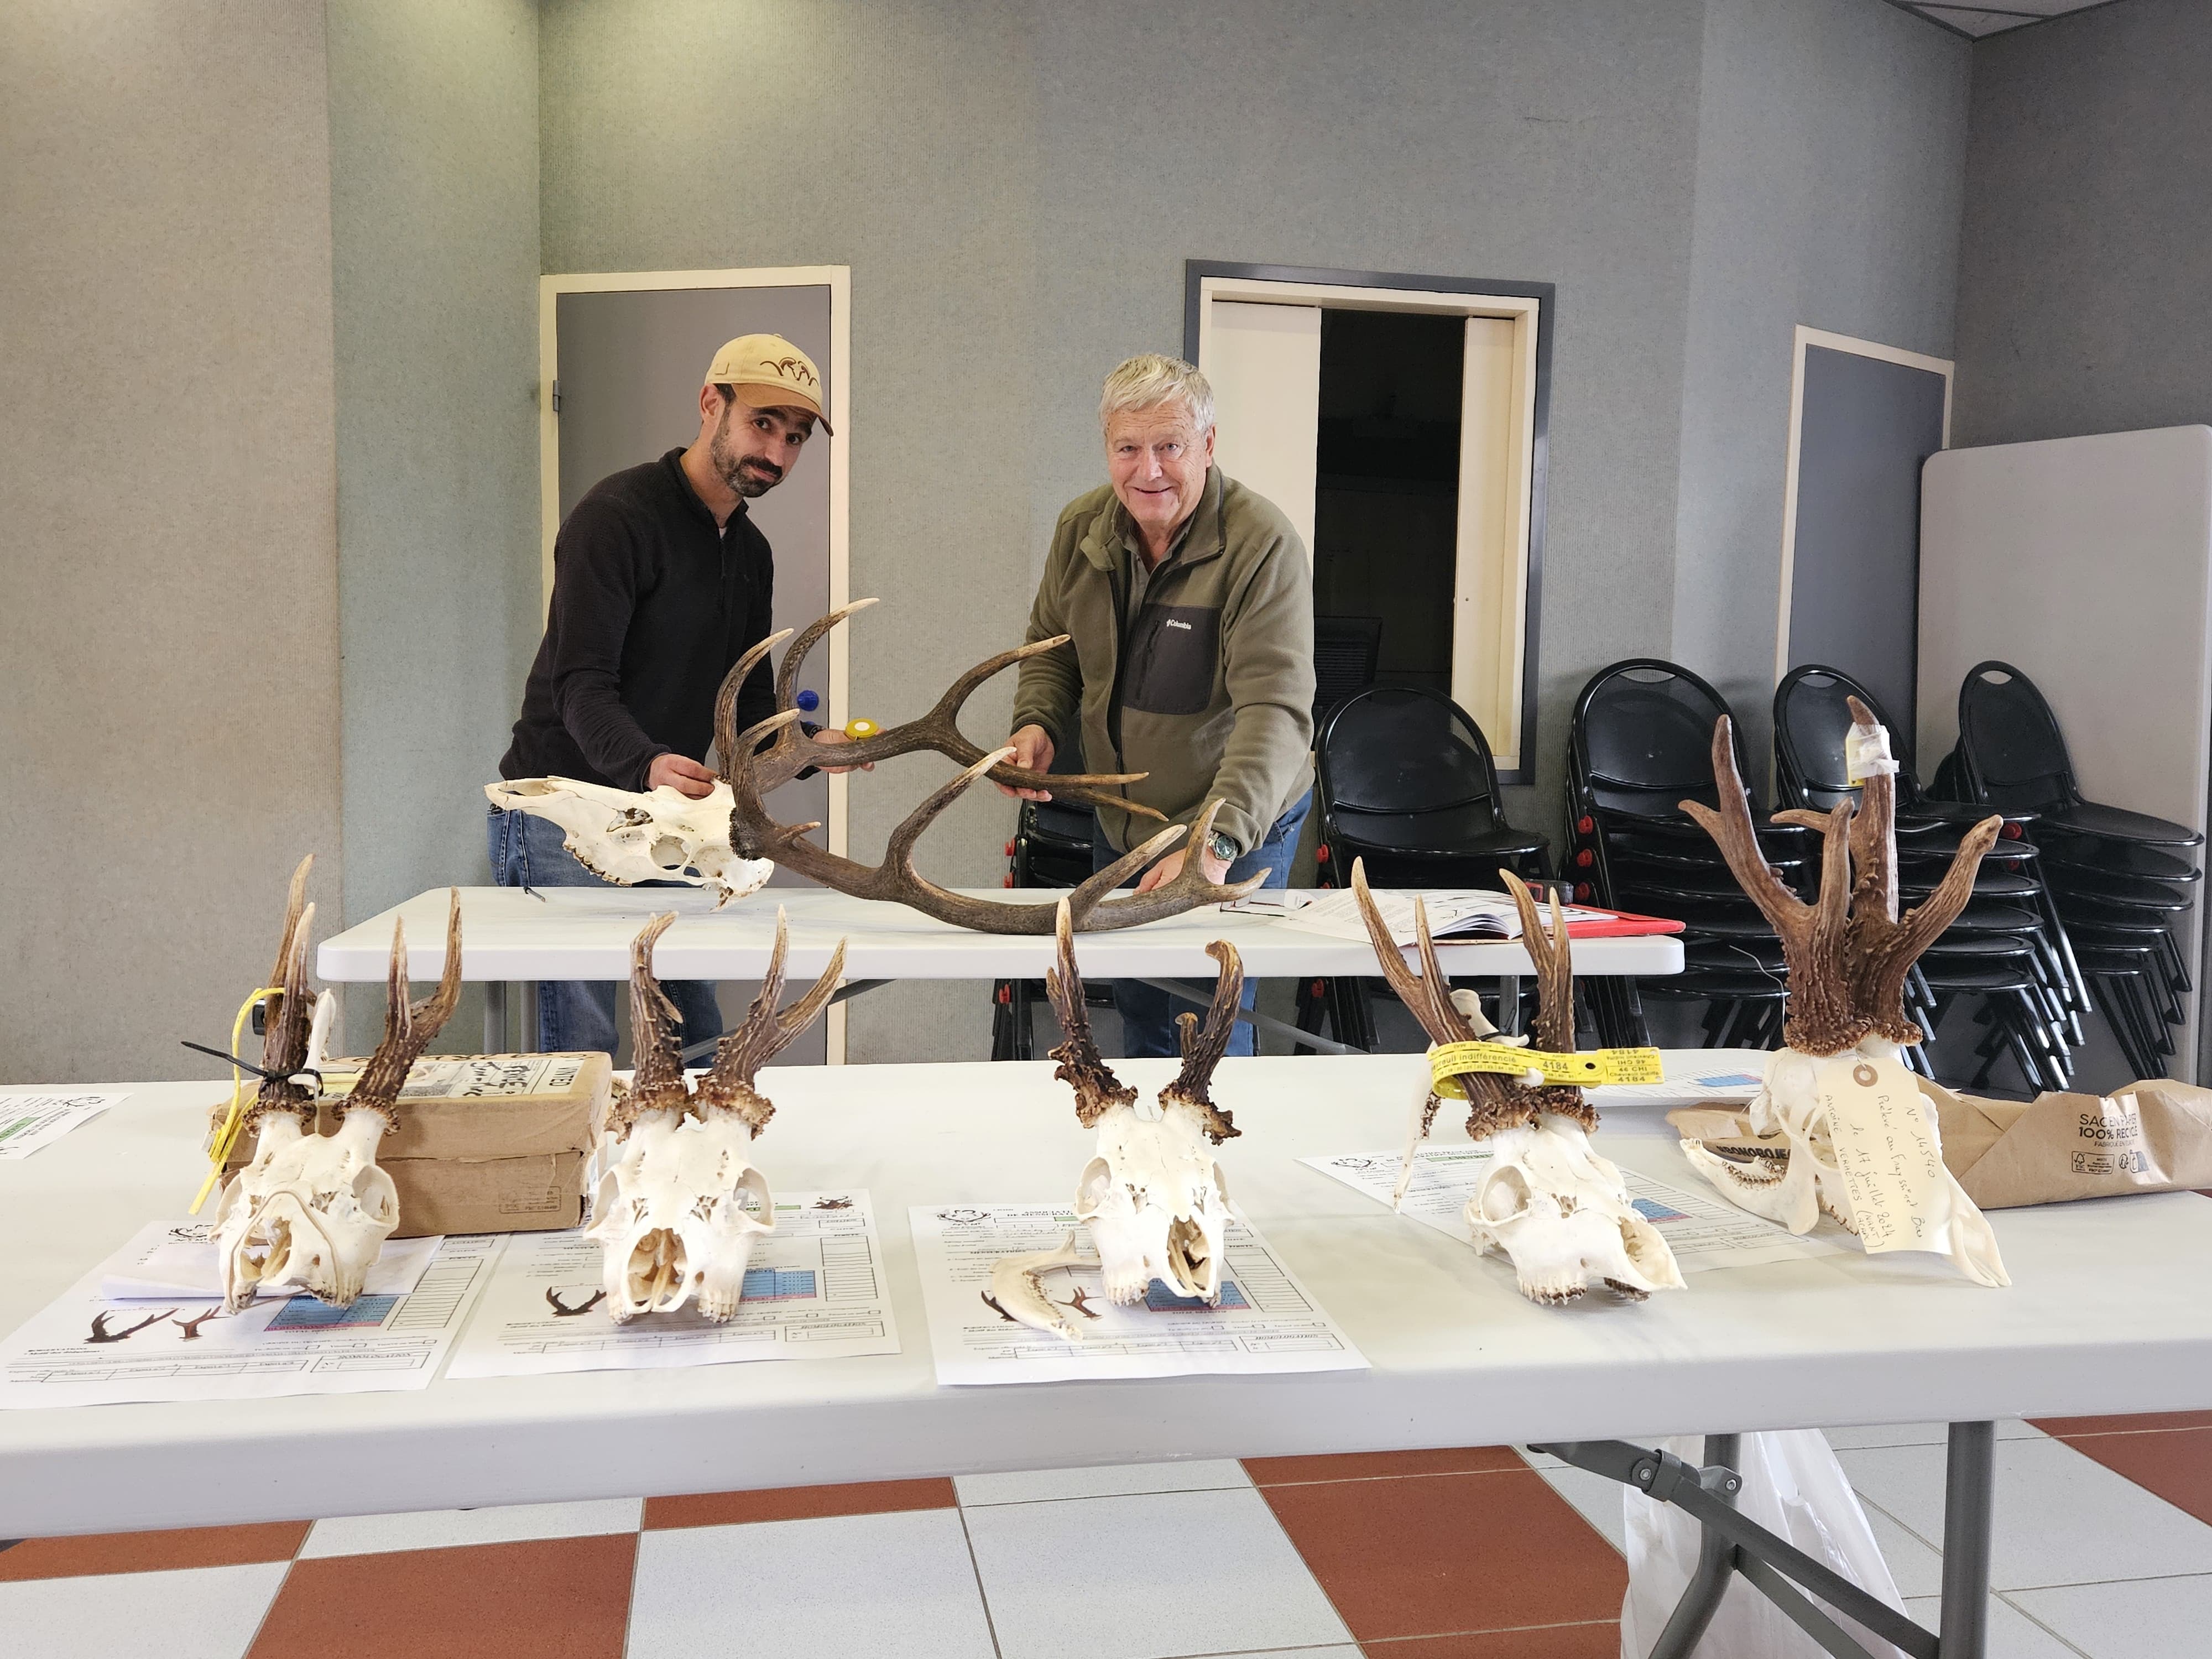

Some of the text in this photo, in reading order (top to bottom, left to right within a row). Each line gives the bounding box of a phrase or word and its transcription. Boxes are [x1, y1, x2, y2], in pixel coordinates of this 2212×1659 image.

[1543, 1061, 1569, 1071] 4184
[2079, 1114, 2107, 1127] SAC
[2079, 1126, 2114, 1139] 100%
[1856, 1148, 1871, 1164] 17
[1911, 1131, 1936, 1178] 14540
[1854, 1171, 1883, 1208] juillet
[1877, 1211, 1896, 1238] 2024
